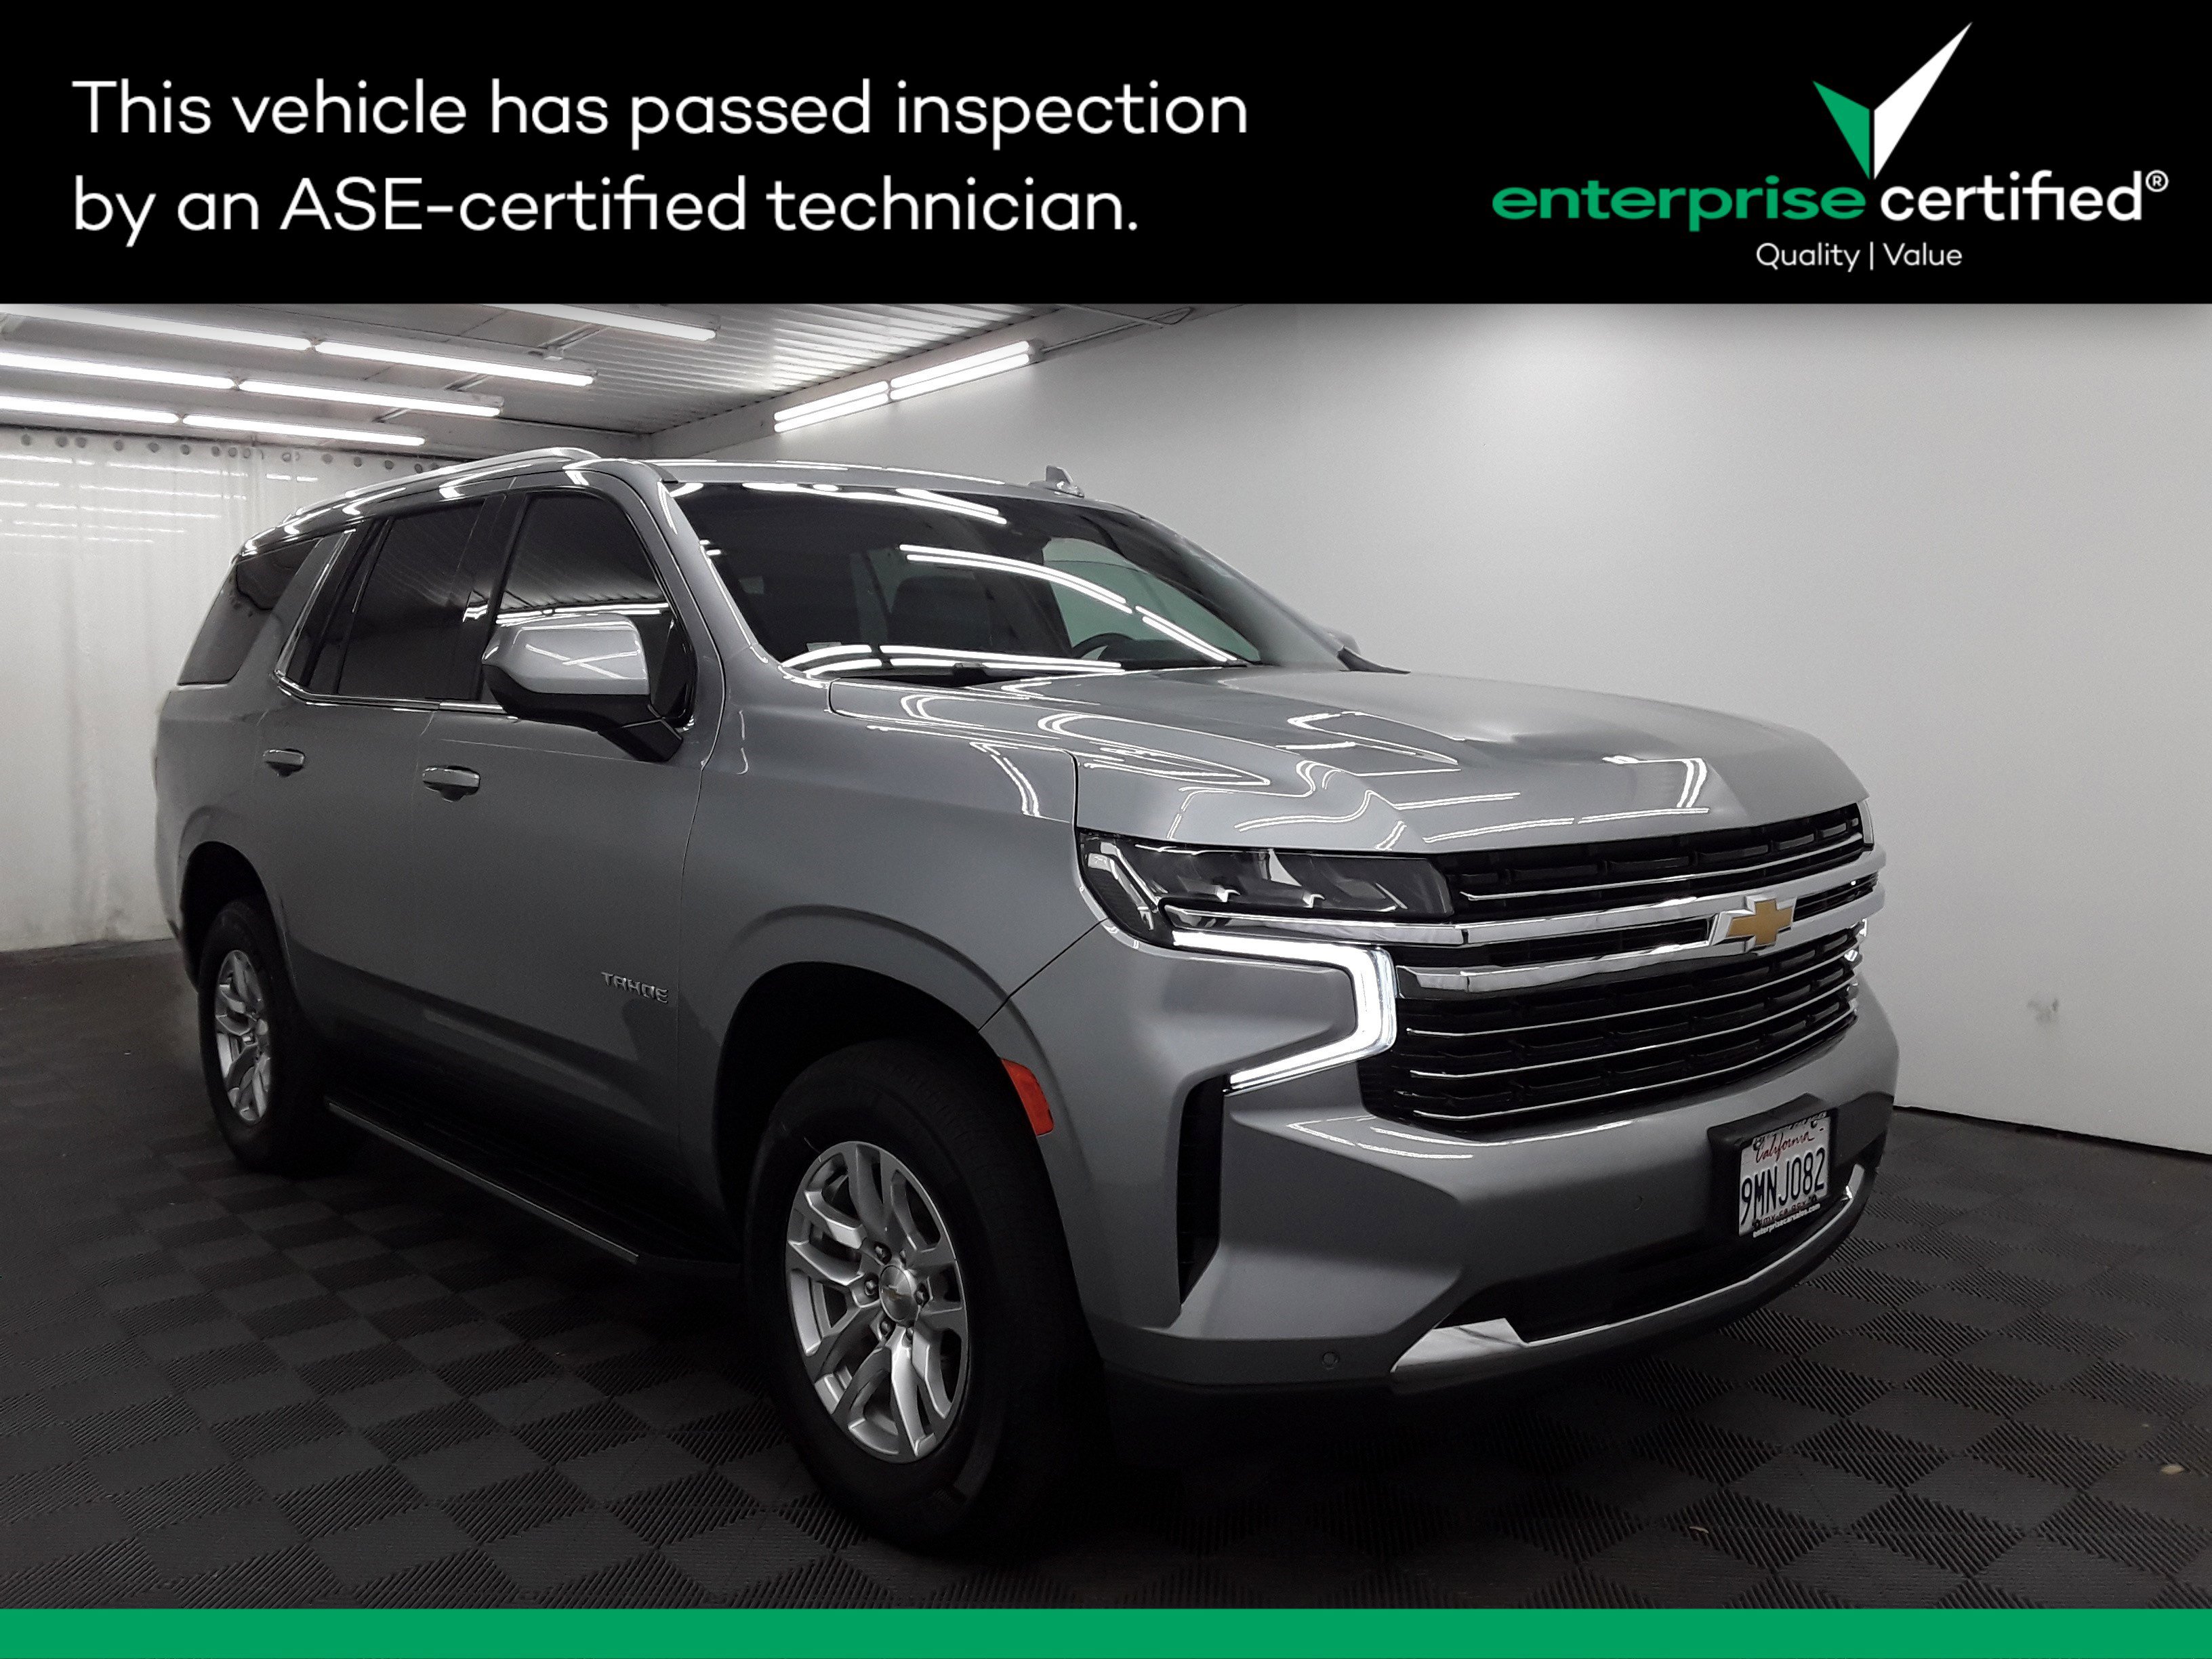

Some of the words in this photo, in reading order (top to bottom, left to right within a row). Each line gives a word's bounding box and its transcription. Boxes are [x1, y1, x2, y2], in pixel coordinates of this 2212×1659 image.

[600, 971, 669, 1004] TAHOE
[1755, 1131, 1816, 1164] California
[1740, 1147, 1826, 1226] 9MNJ082
